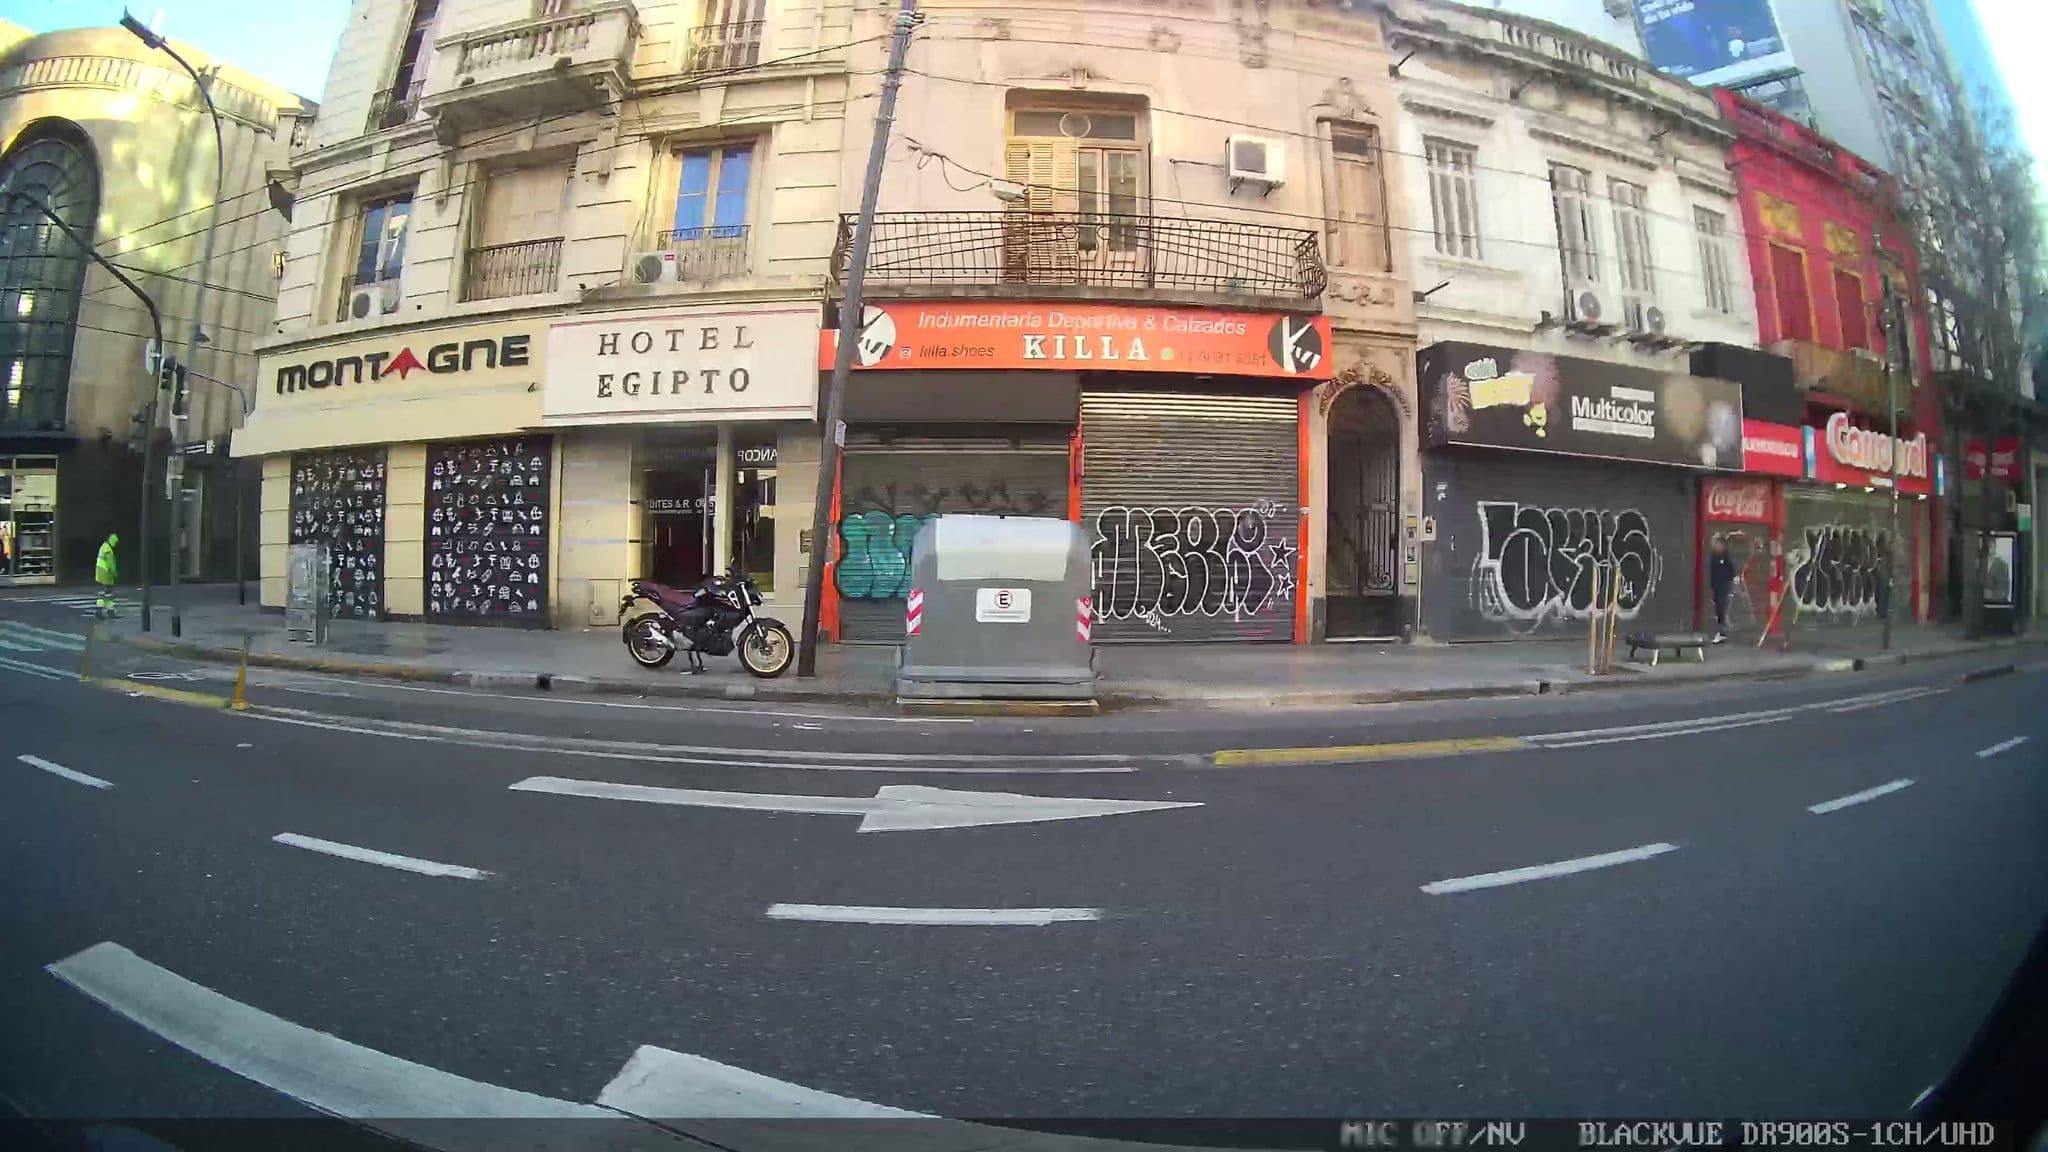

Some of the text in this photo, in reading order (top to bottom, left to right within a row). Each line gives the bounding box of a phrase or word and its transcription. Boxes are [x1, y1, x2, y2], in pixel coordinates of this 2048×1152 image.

[918, 311, 1042, 329] Indumentaria
[1143, 315, 1157, 331] &
[1163, 315, 1247, 336] Calzados
[597, 325, 754, 356] HOTEL
[1023, 334, 1149, 361] KILLA
[597, 367, 750, 398] EGIPTO
[1572, 395, 1655, 425] Multicolor
